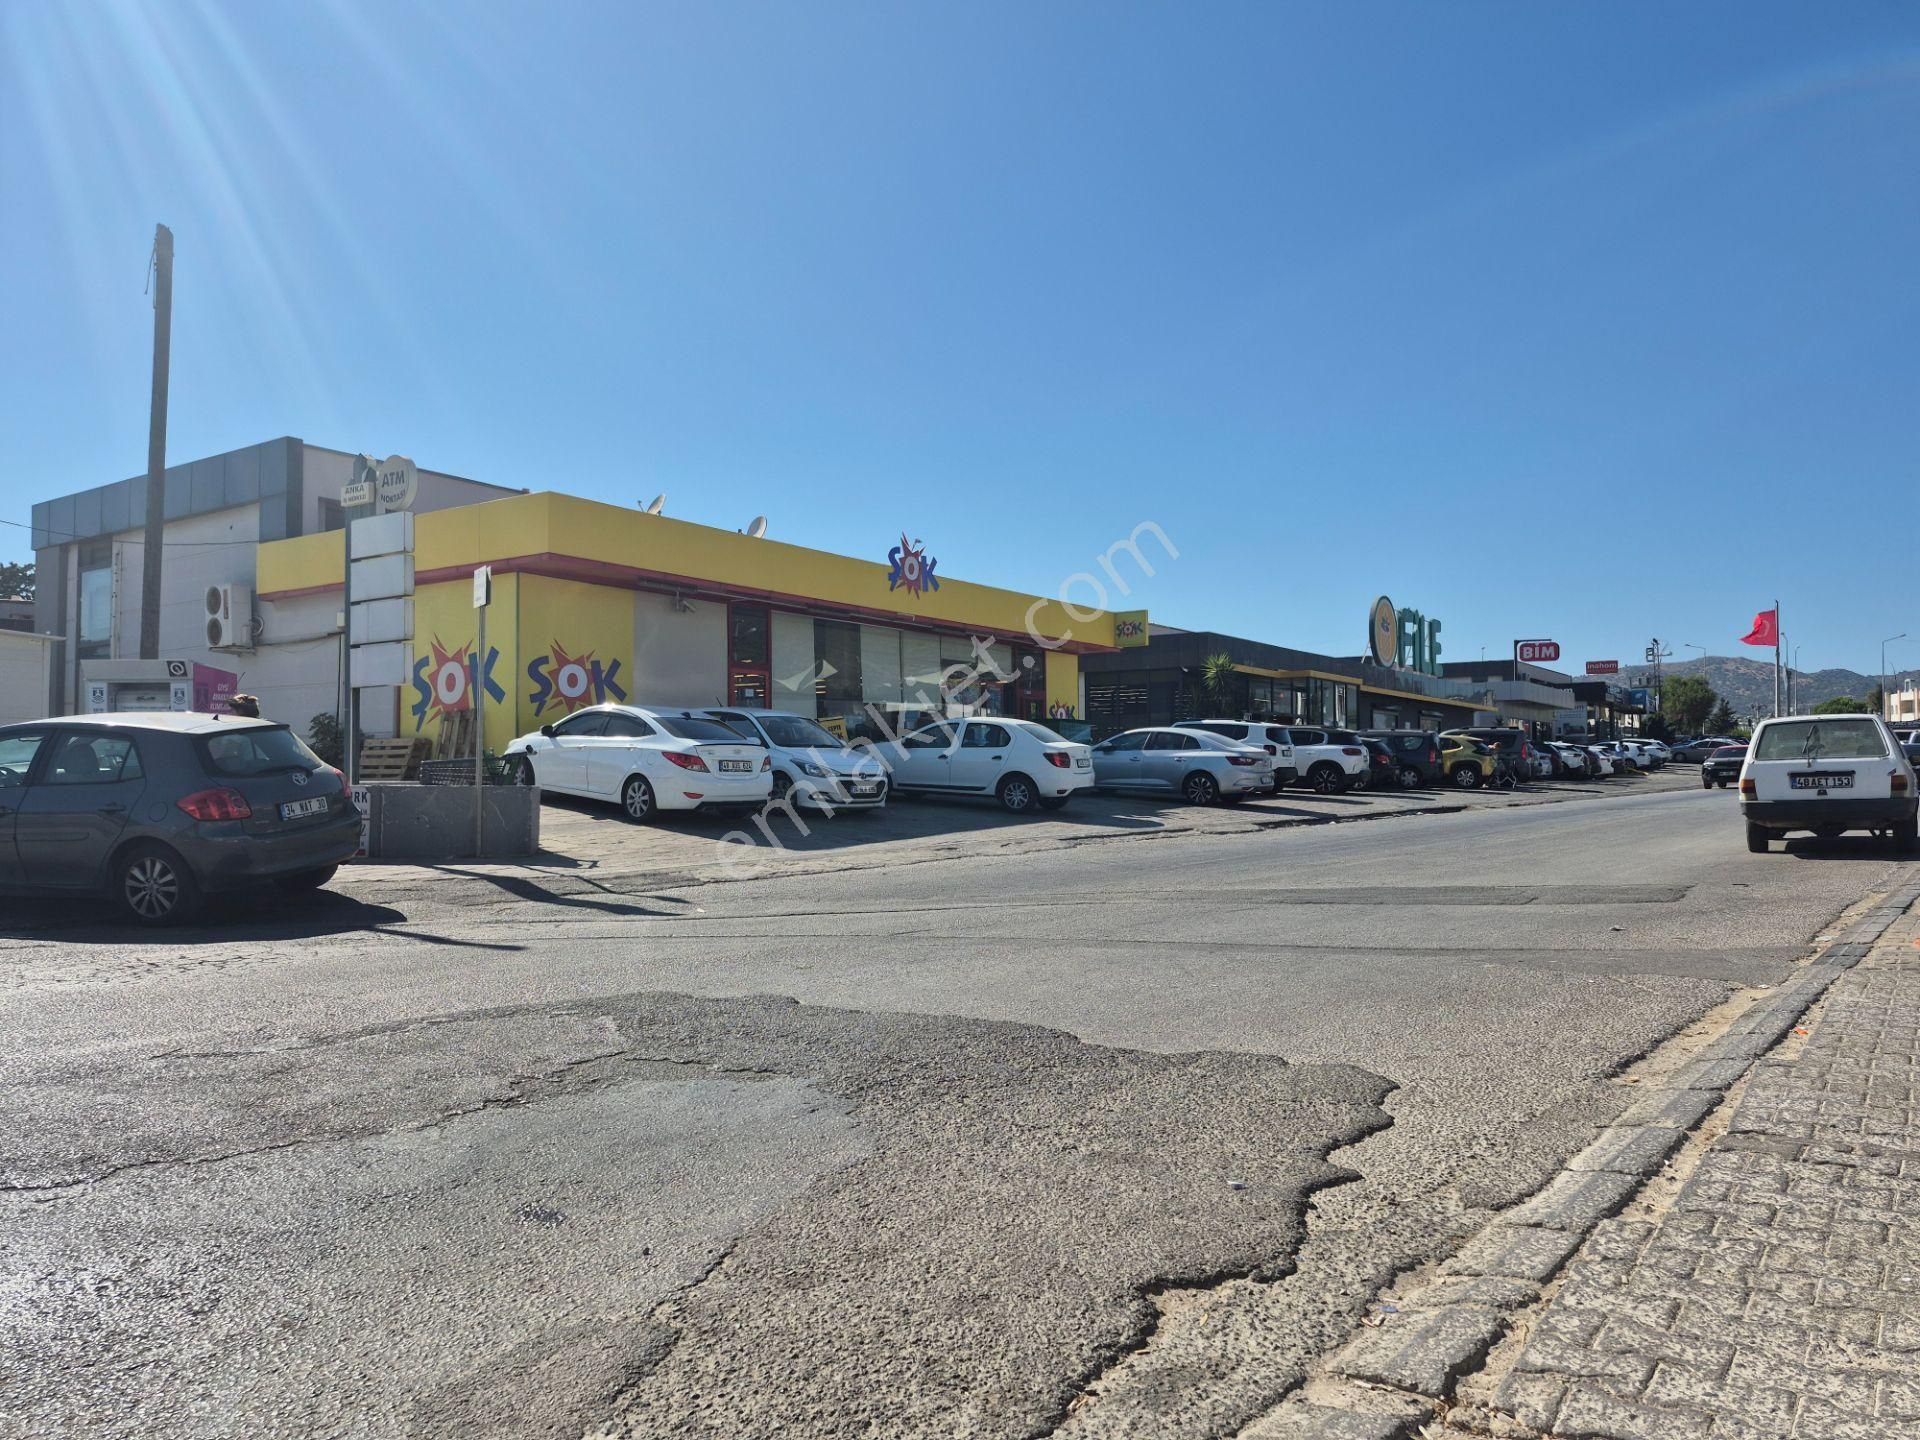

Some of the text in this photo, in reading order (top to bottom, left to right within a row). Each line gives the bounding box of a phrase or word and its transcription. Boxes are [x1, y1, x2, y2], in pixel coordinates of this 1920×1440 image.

[382, 470, 405, 488] ATM
[345, 484, 365, 495] ANKA
[888, 545, 940, 593] ŞOK
[1522, 642, 1555, 660] BİM
[411, 645, 506, 733] ŞOK
[528, 655, 628, 718] ŞOK
[1832, 776, 1851, 786] 153
[285, 803, 296, 816] 34
